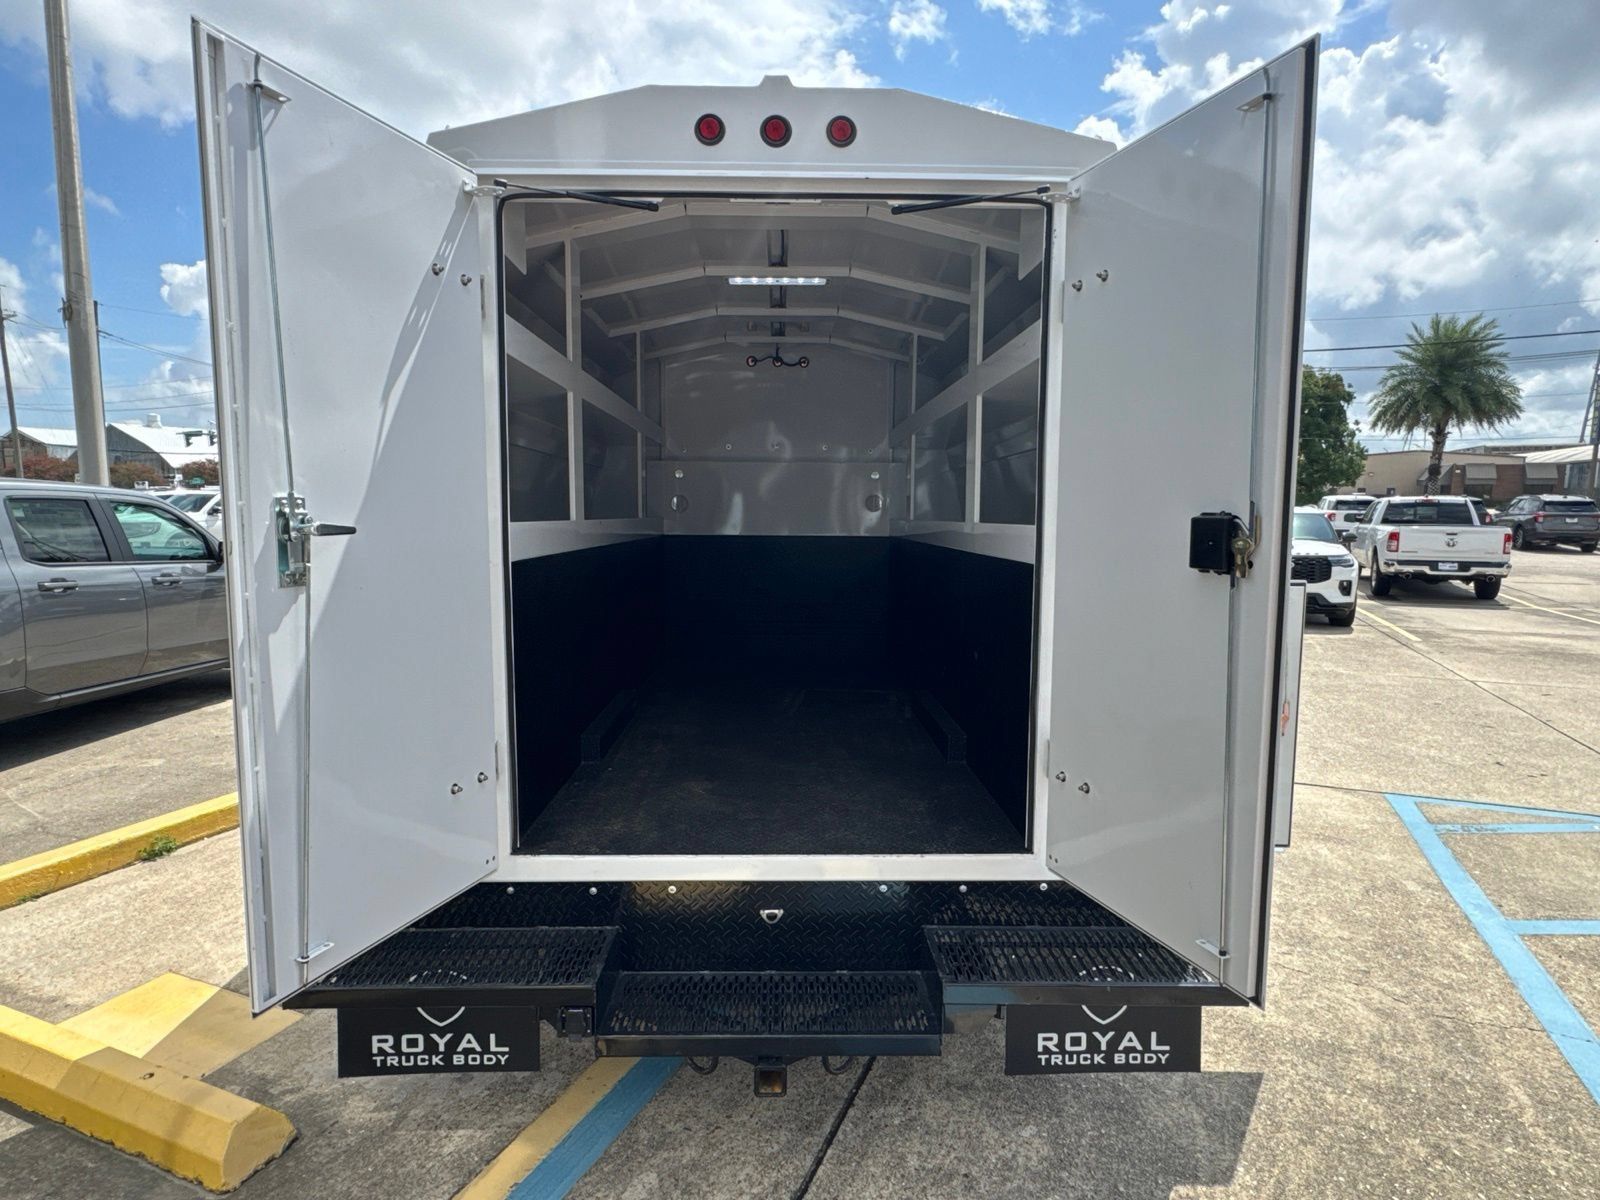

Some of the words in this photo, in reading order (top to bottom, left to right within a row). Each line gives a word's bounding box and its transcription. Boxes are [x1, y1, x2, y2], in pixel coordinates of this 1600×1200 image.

[371, 1033, 510, 1054] ROYAL
[1037, 1031, 1171, 1053] ROYAL
[372, 1054, 445, 1067] TRUCK
[452, 1054, 509, 1066] BODY
[1037, 1053, 1106, 1066] TRUCK
[1113, 1052, 1170, 1065] BODY
